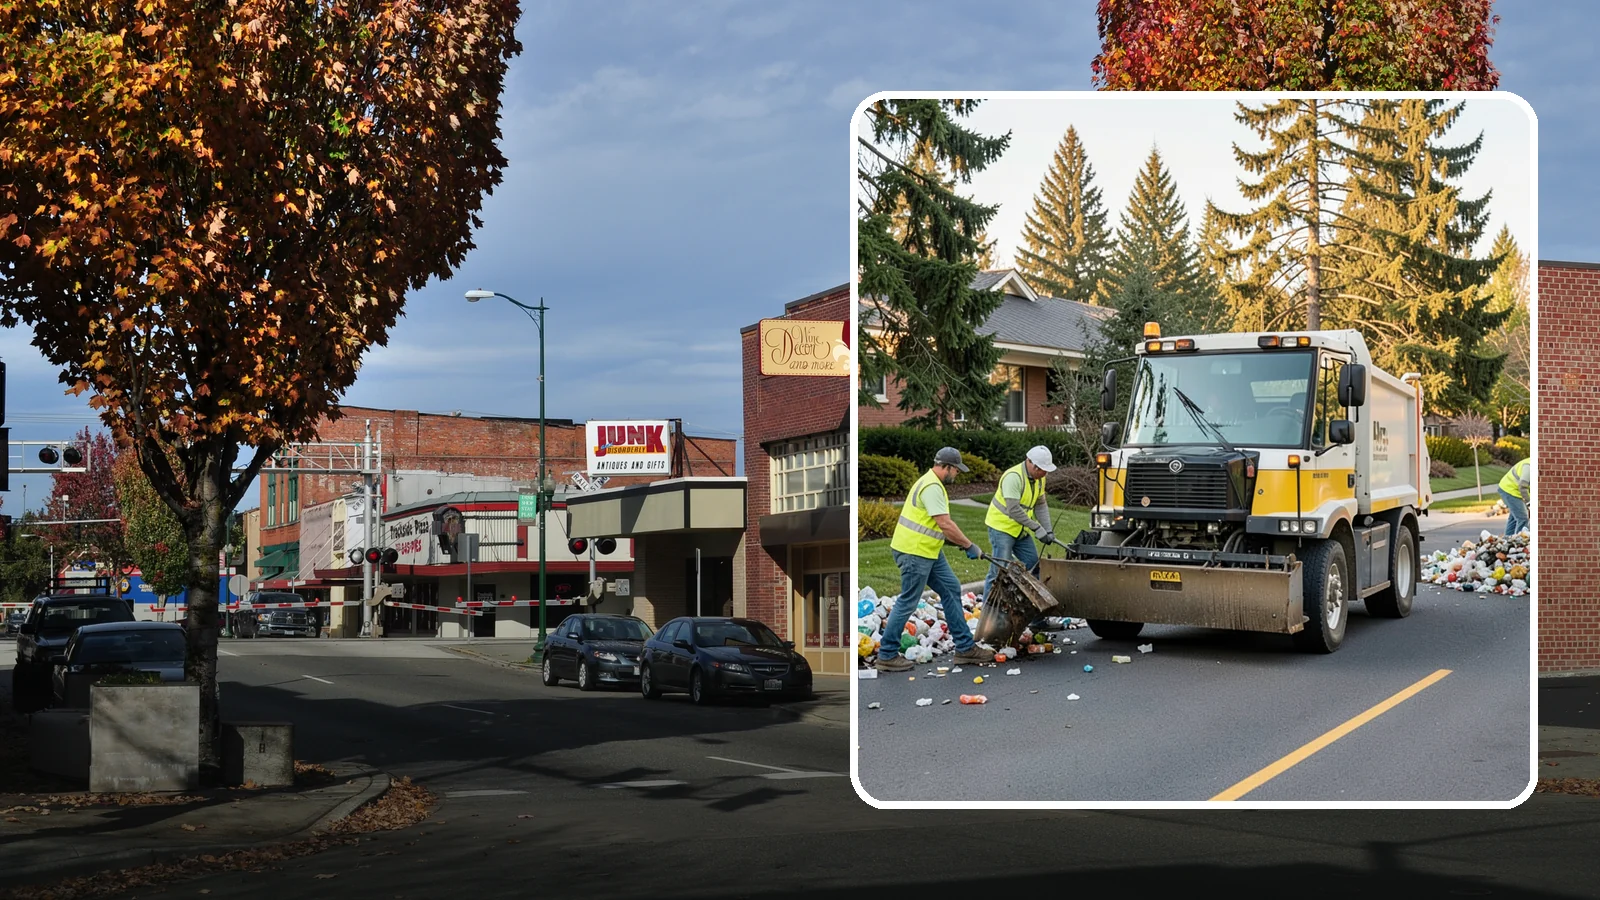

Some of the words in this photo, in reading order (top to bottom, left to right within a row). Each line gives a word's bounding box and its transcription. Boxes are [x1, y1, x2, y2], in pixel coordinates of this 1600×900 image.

[596, 425, 664, 457] JUNK
[607, 446, 646, 454] DISORDERLY
[597, 461, 628, 470] ANTIQUES
[631, 461, 644, 470] AND
[647, 460, 665, 469] GIFTS
